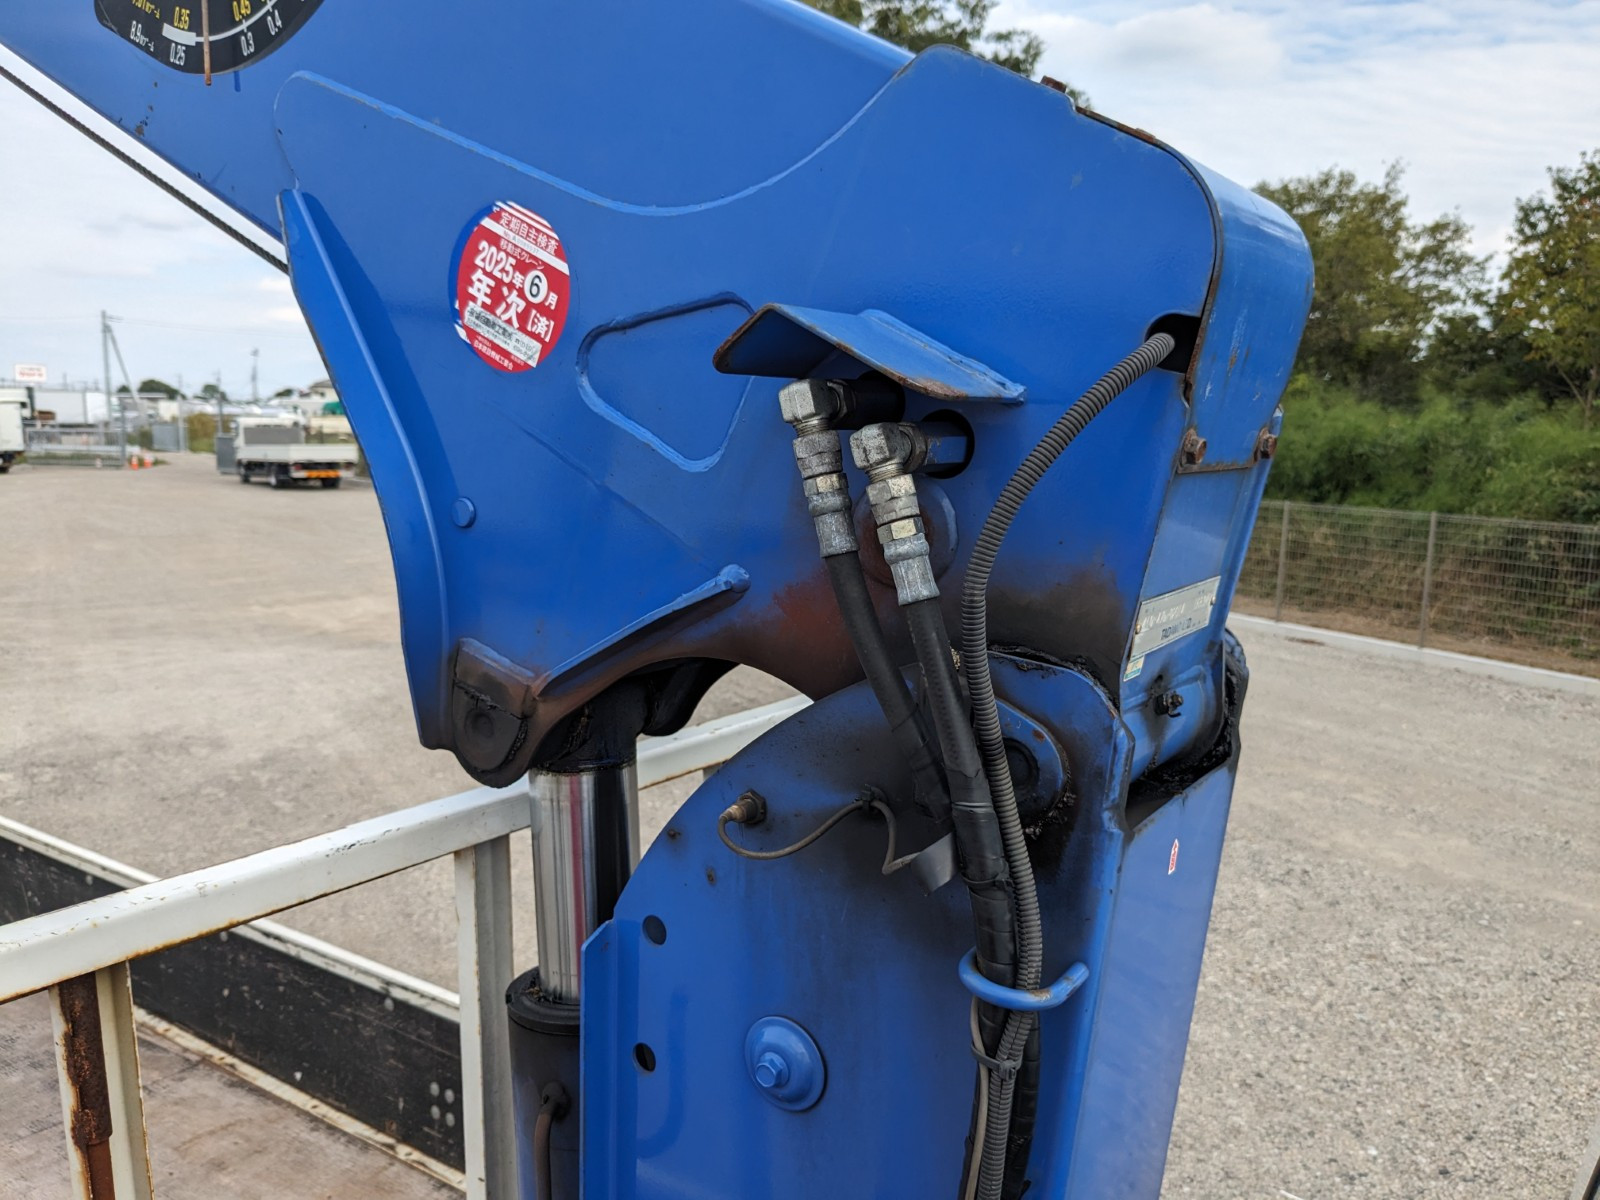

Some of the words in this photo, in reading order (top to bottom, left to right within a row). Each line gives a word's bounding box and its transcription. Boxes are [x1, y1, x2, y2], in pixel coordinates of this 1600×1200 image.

[173, 6, 190, 30] 0.35
[232, 0, 252, 21] 0.45
[266, 9, 282, 35] 0.4
[169, 43, 186, 66] 0.25
[240, 31, 255, 56] 0.3
[499, 211, 559, 256] 定期自主検査
[499, 239, 545, 270] 移動式クレーン
